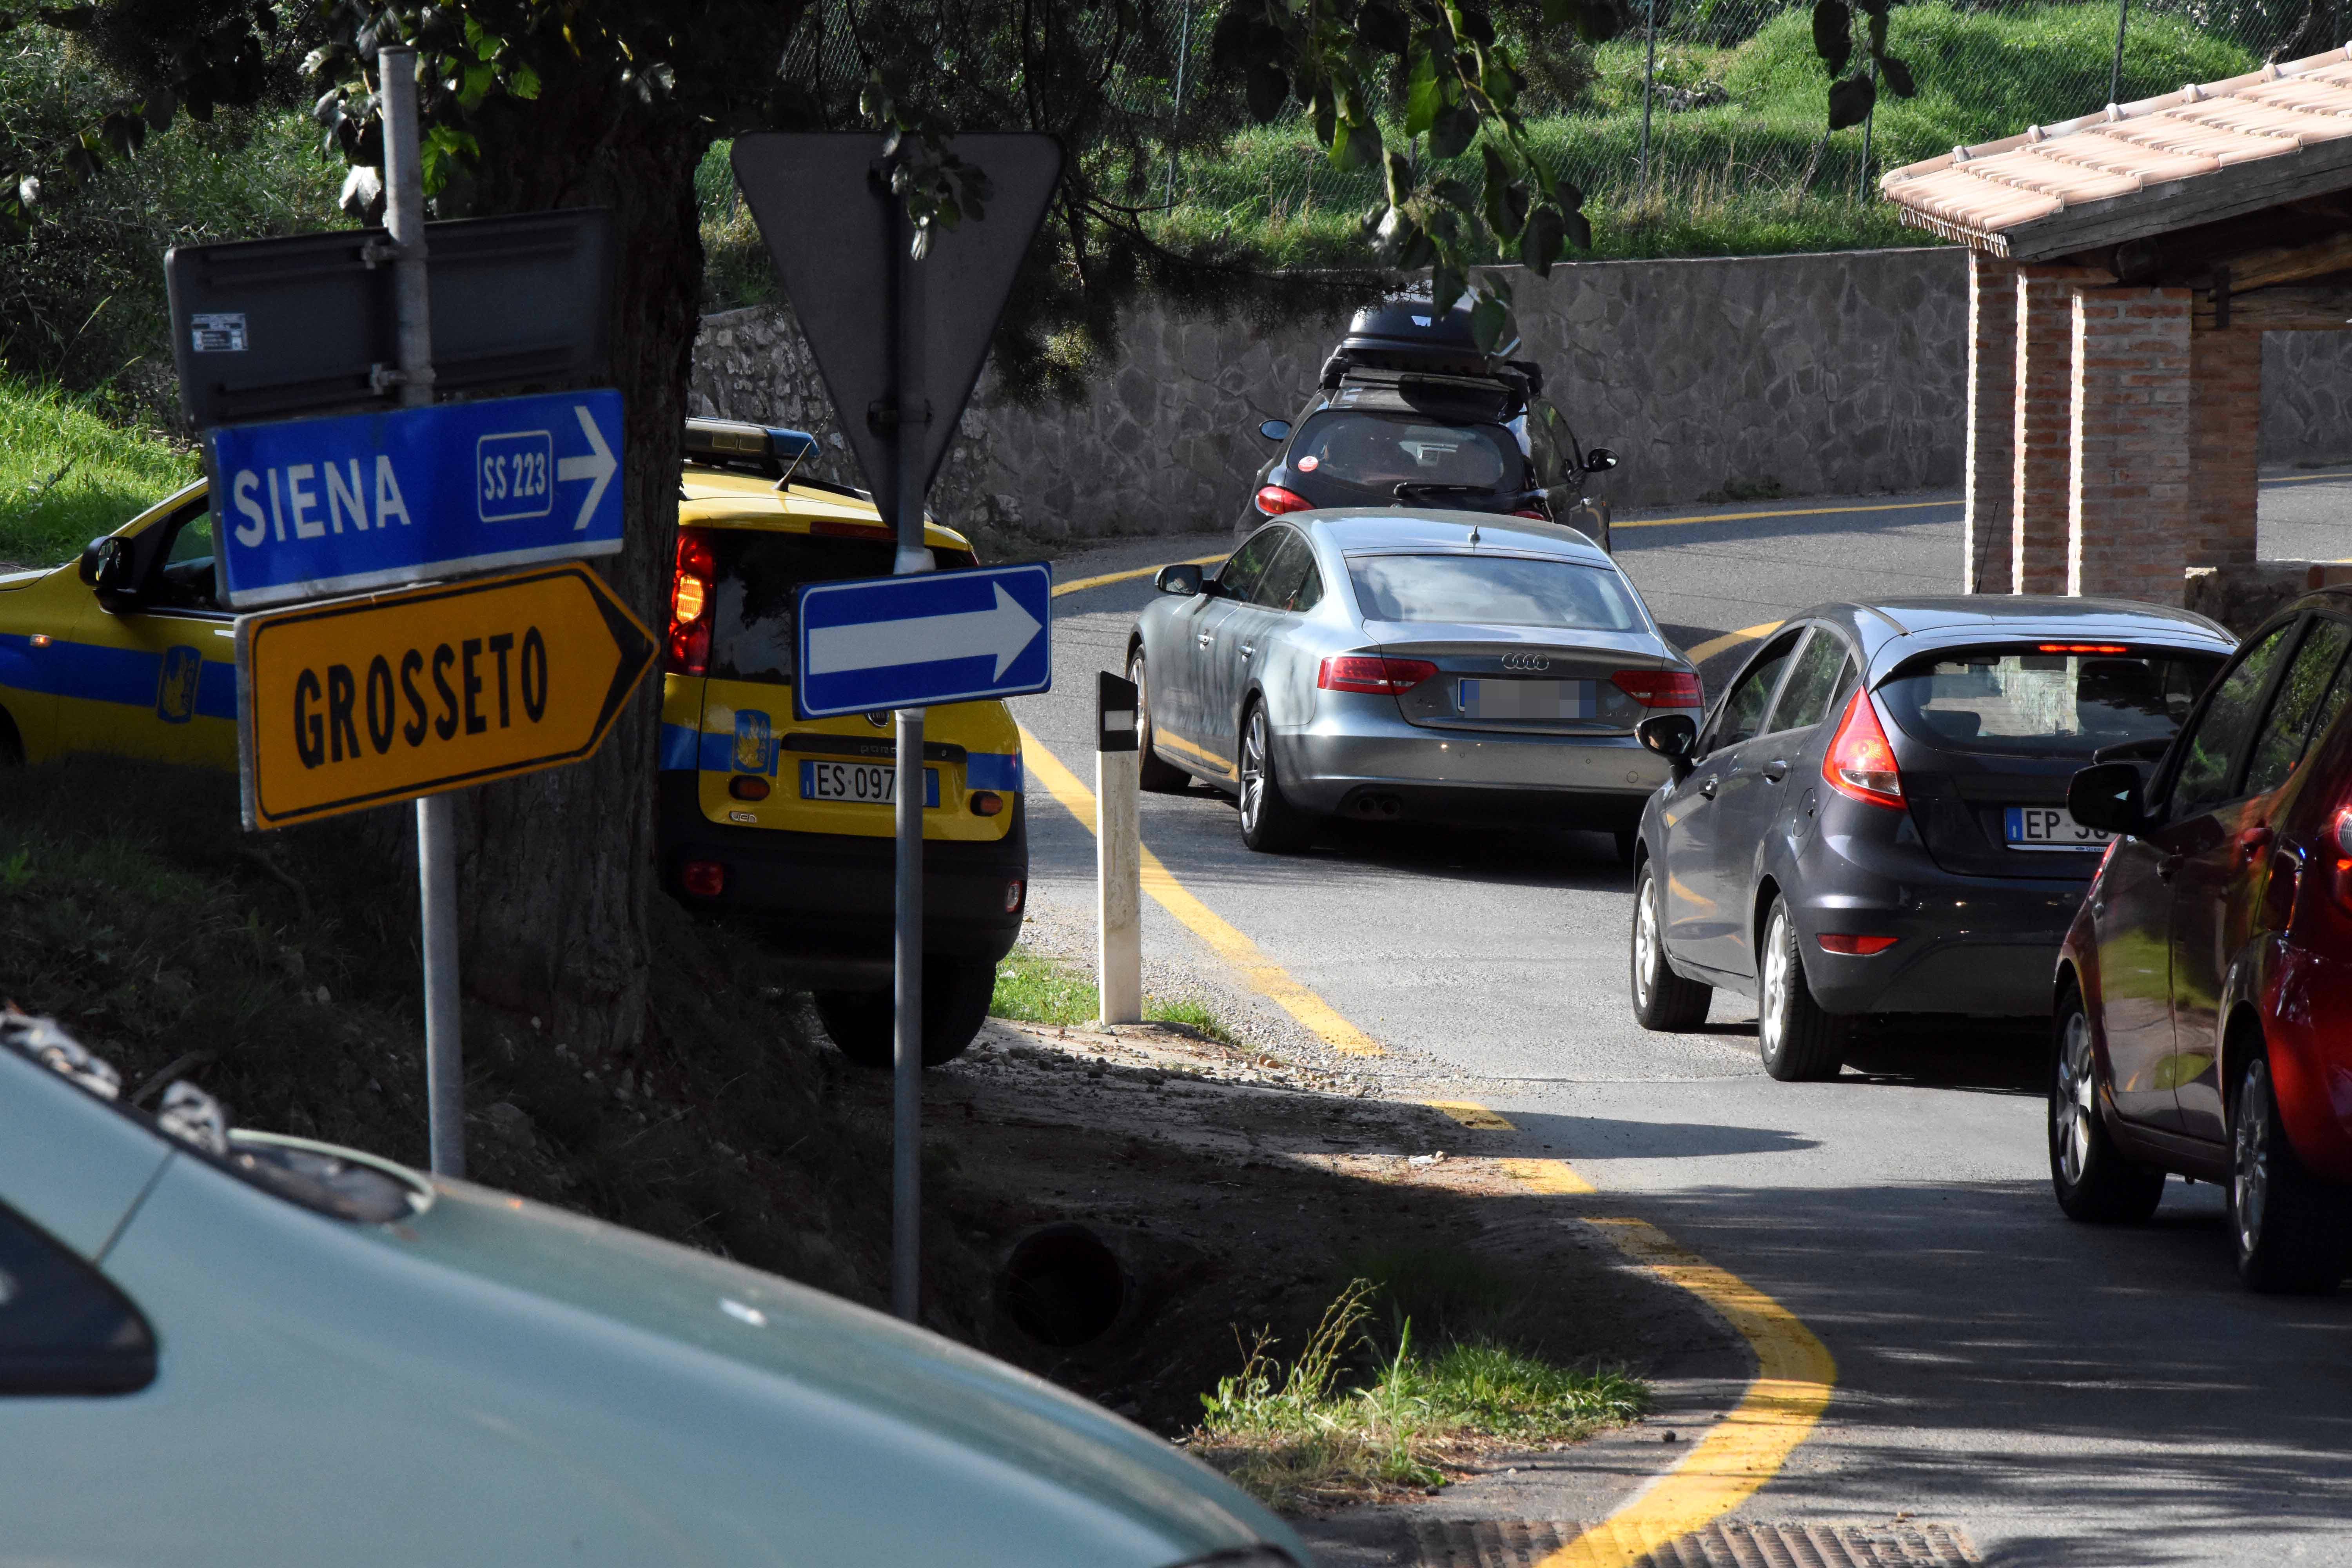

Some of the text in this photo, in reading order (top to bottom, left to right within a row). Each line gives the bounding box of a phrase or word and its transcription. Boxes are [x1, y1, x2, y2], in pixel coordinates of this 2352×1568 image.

[233, 455, 411, 547] SIENA
[484, 452, 546, 500] SS 223
[294, 626, 548, 769] GROSSETO
[757, 720, 767, 764] ANAS
